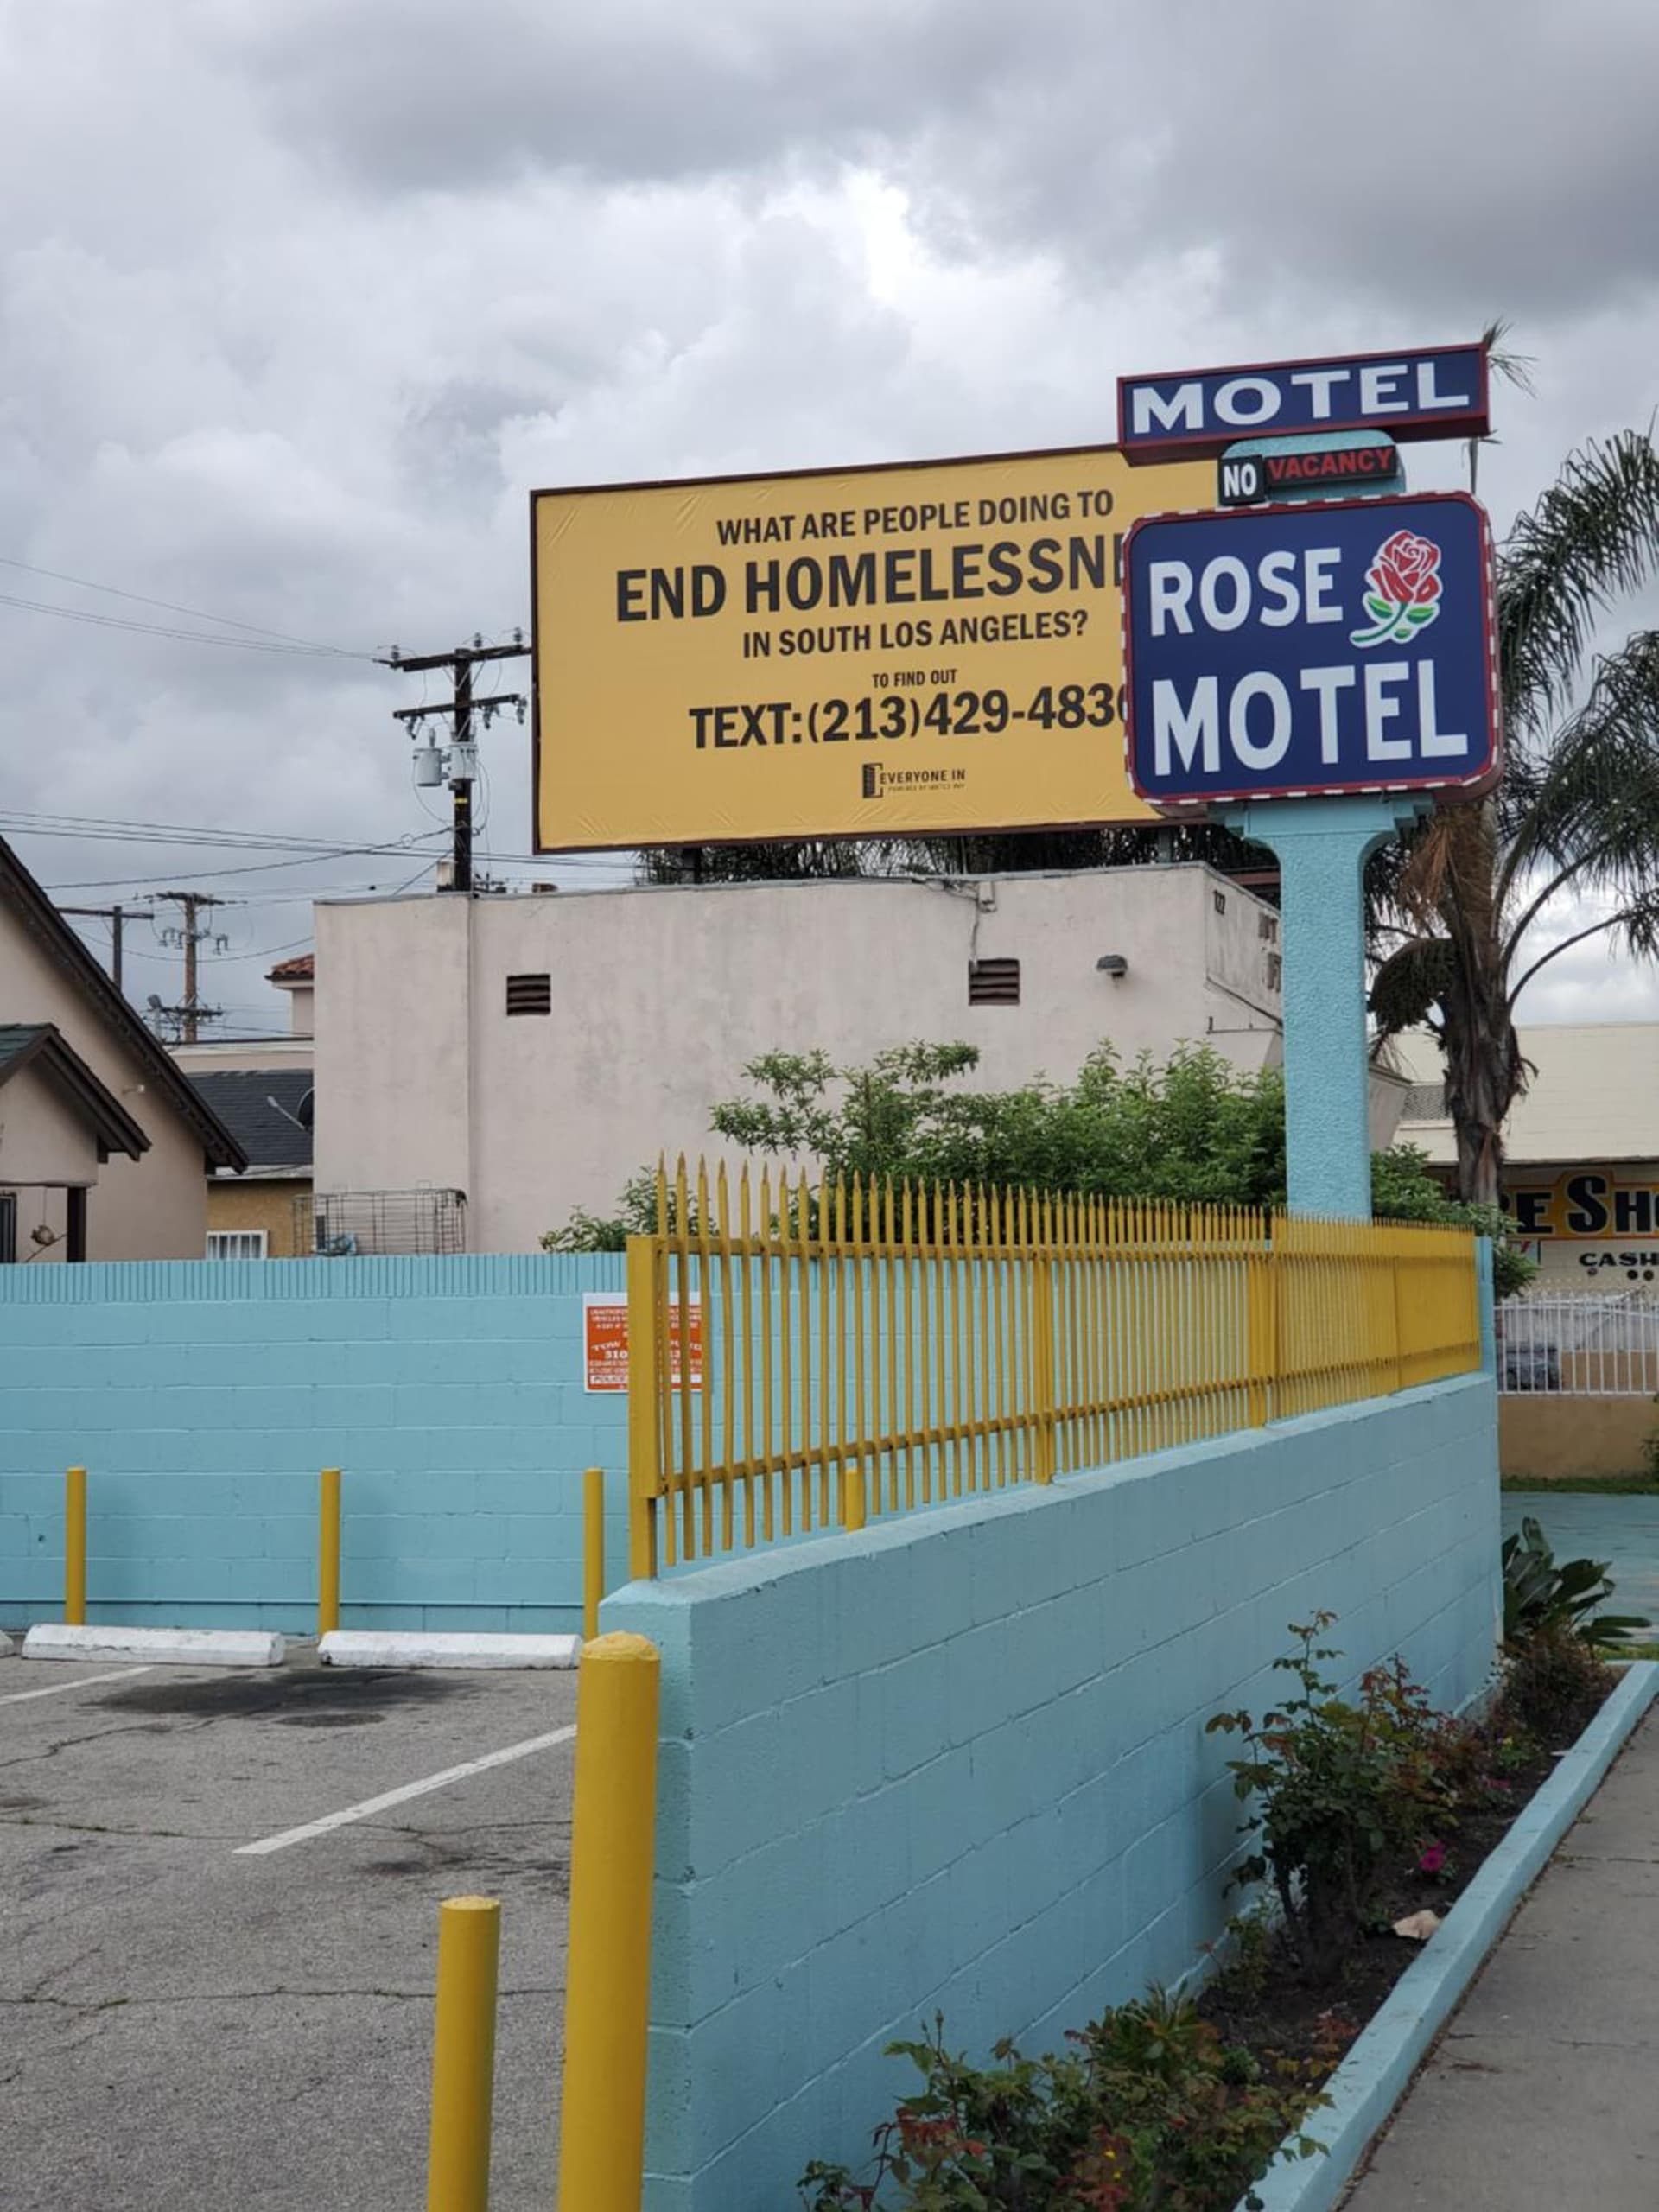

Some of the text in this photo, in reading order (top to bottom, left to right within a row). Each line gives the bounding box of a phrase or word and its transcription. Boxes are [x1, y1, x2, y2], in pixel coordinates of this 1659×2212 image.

[1131, 361, 1470, 434] MOTEL
[1223, 448, 1393, 497] NO VACANCY
[716, 489, 1114, 547] WHAT ARE PEOPLE DOING TO
[616, 564, 727, 623] END
[1149, 547, 1343, 637] ROSE
[743, 608, 1089, 658] IN SOUTH LOS ANGELES?
[872, 668, 958, 689] TO FIND OUT
[1152, 659, 1469, 776] MOTEL
[880, 768, 966, 785] EVERYONE IN
[1566, 1174, 1659, 1234] SH
[1579, 1252, 1659, 1268] CASH
